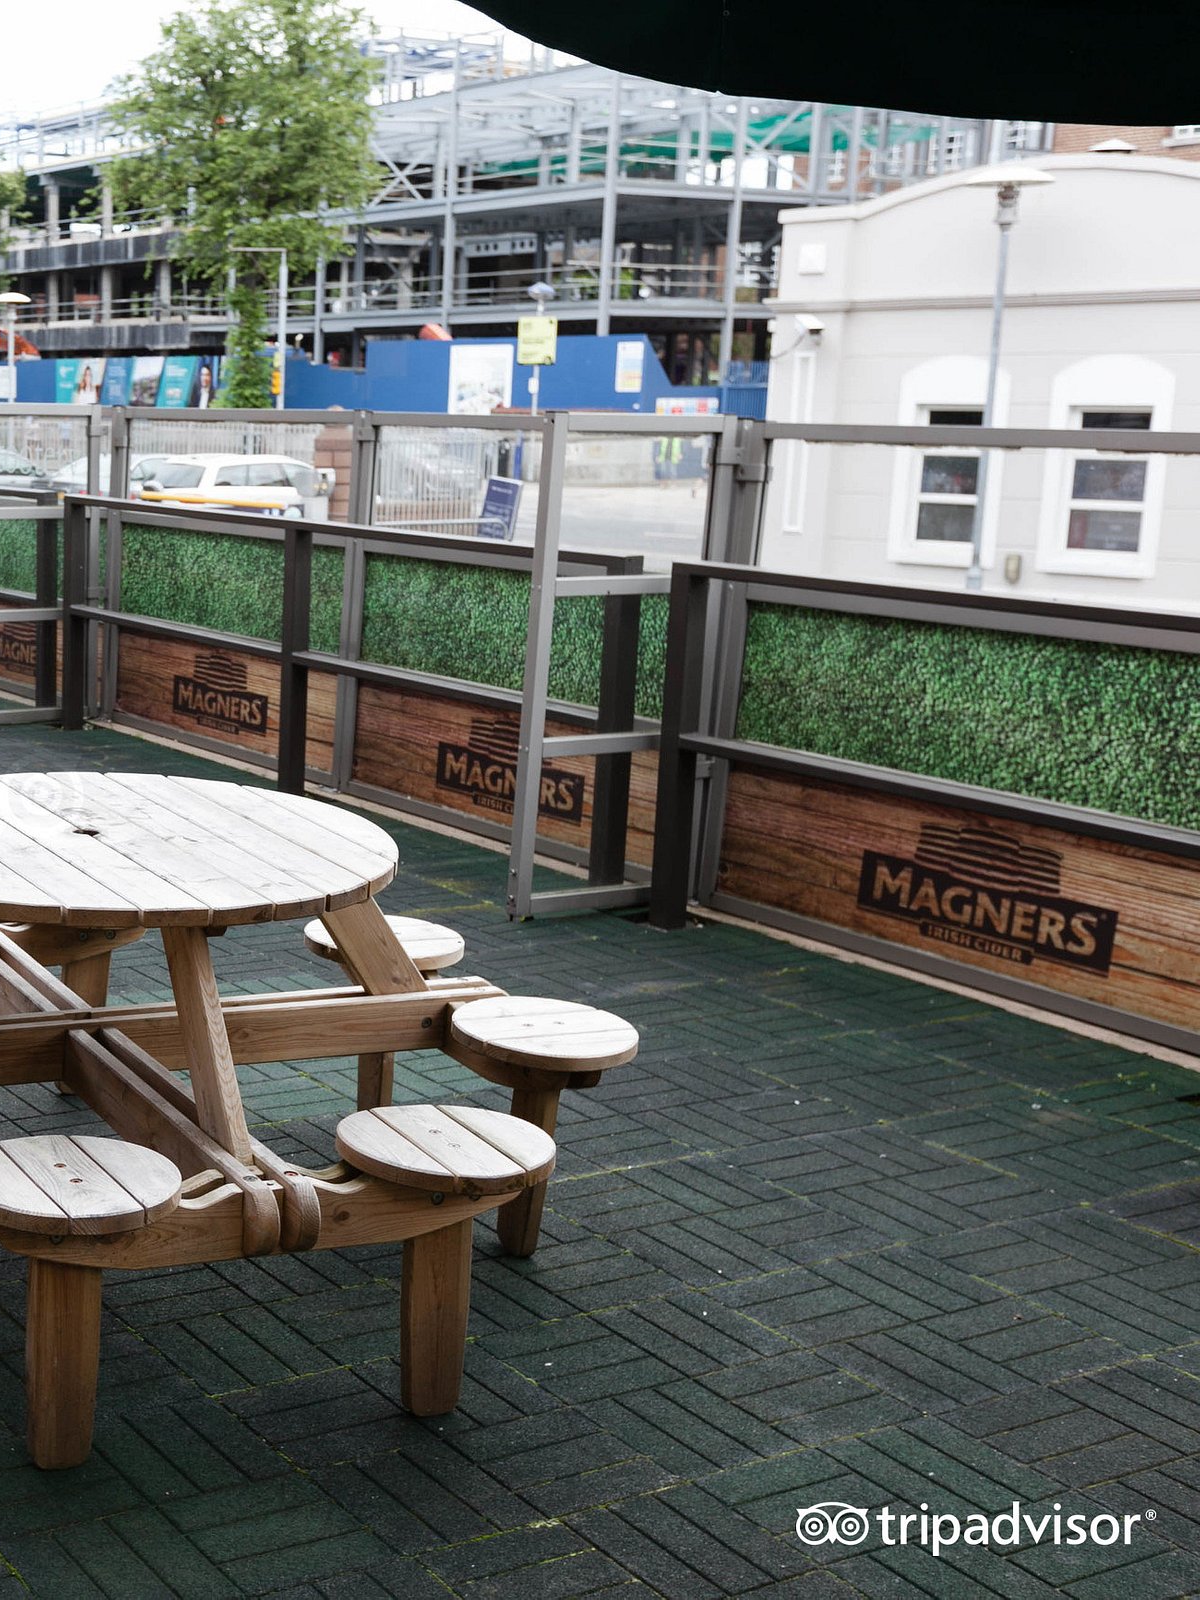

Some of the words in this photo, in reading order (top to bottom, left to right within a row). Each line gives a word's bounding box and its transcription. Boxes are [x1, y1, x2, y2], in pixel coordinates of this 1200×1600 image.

[178, 683, 262, 726] MAGNERS
[444, 751, 575, 811] MAGNRS
[873, 859, 1098, 957] MAGNERS
[927, 925, 972, 947] IRISH
[973, 938, 1023, 962] CIDER
